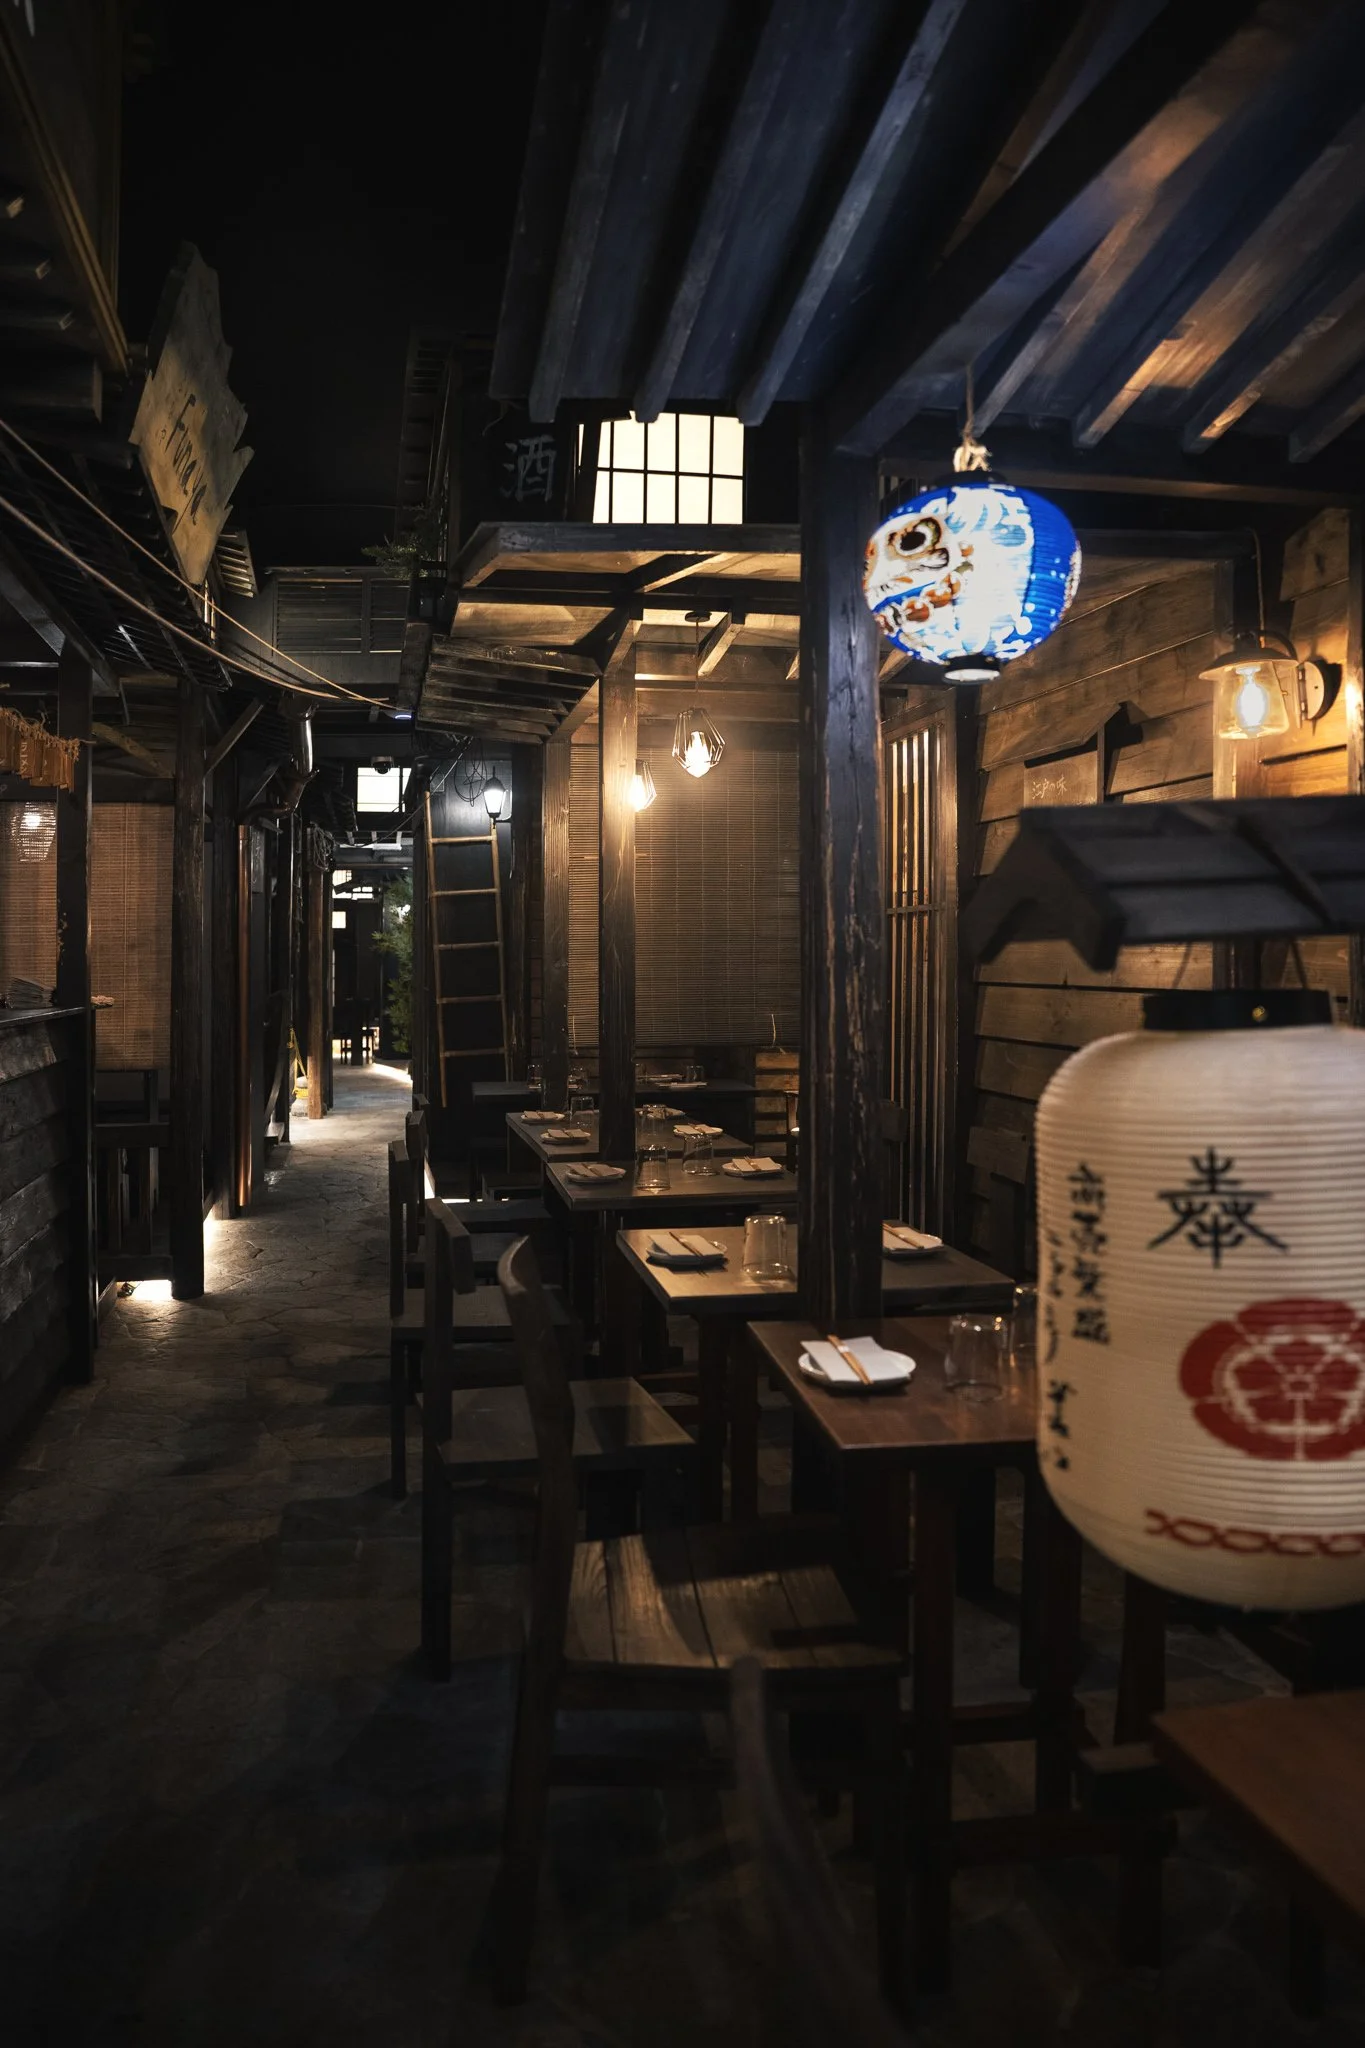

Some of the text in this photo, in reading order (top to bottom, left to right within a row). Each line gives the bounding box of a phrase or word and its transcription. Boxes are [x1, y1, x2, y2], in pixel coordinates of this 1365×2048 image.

[165, 393, 208, 535] Funaya
[500, 434, 557, 502] 酒
[1032, 774, 1068, 800] 江戸の味
